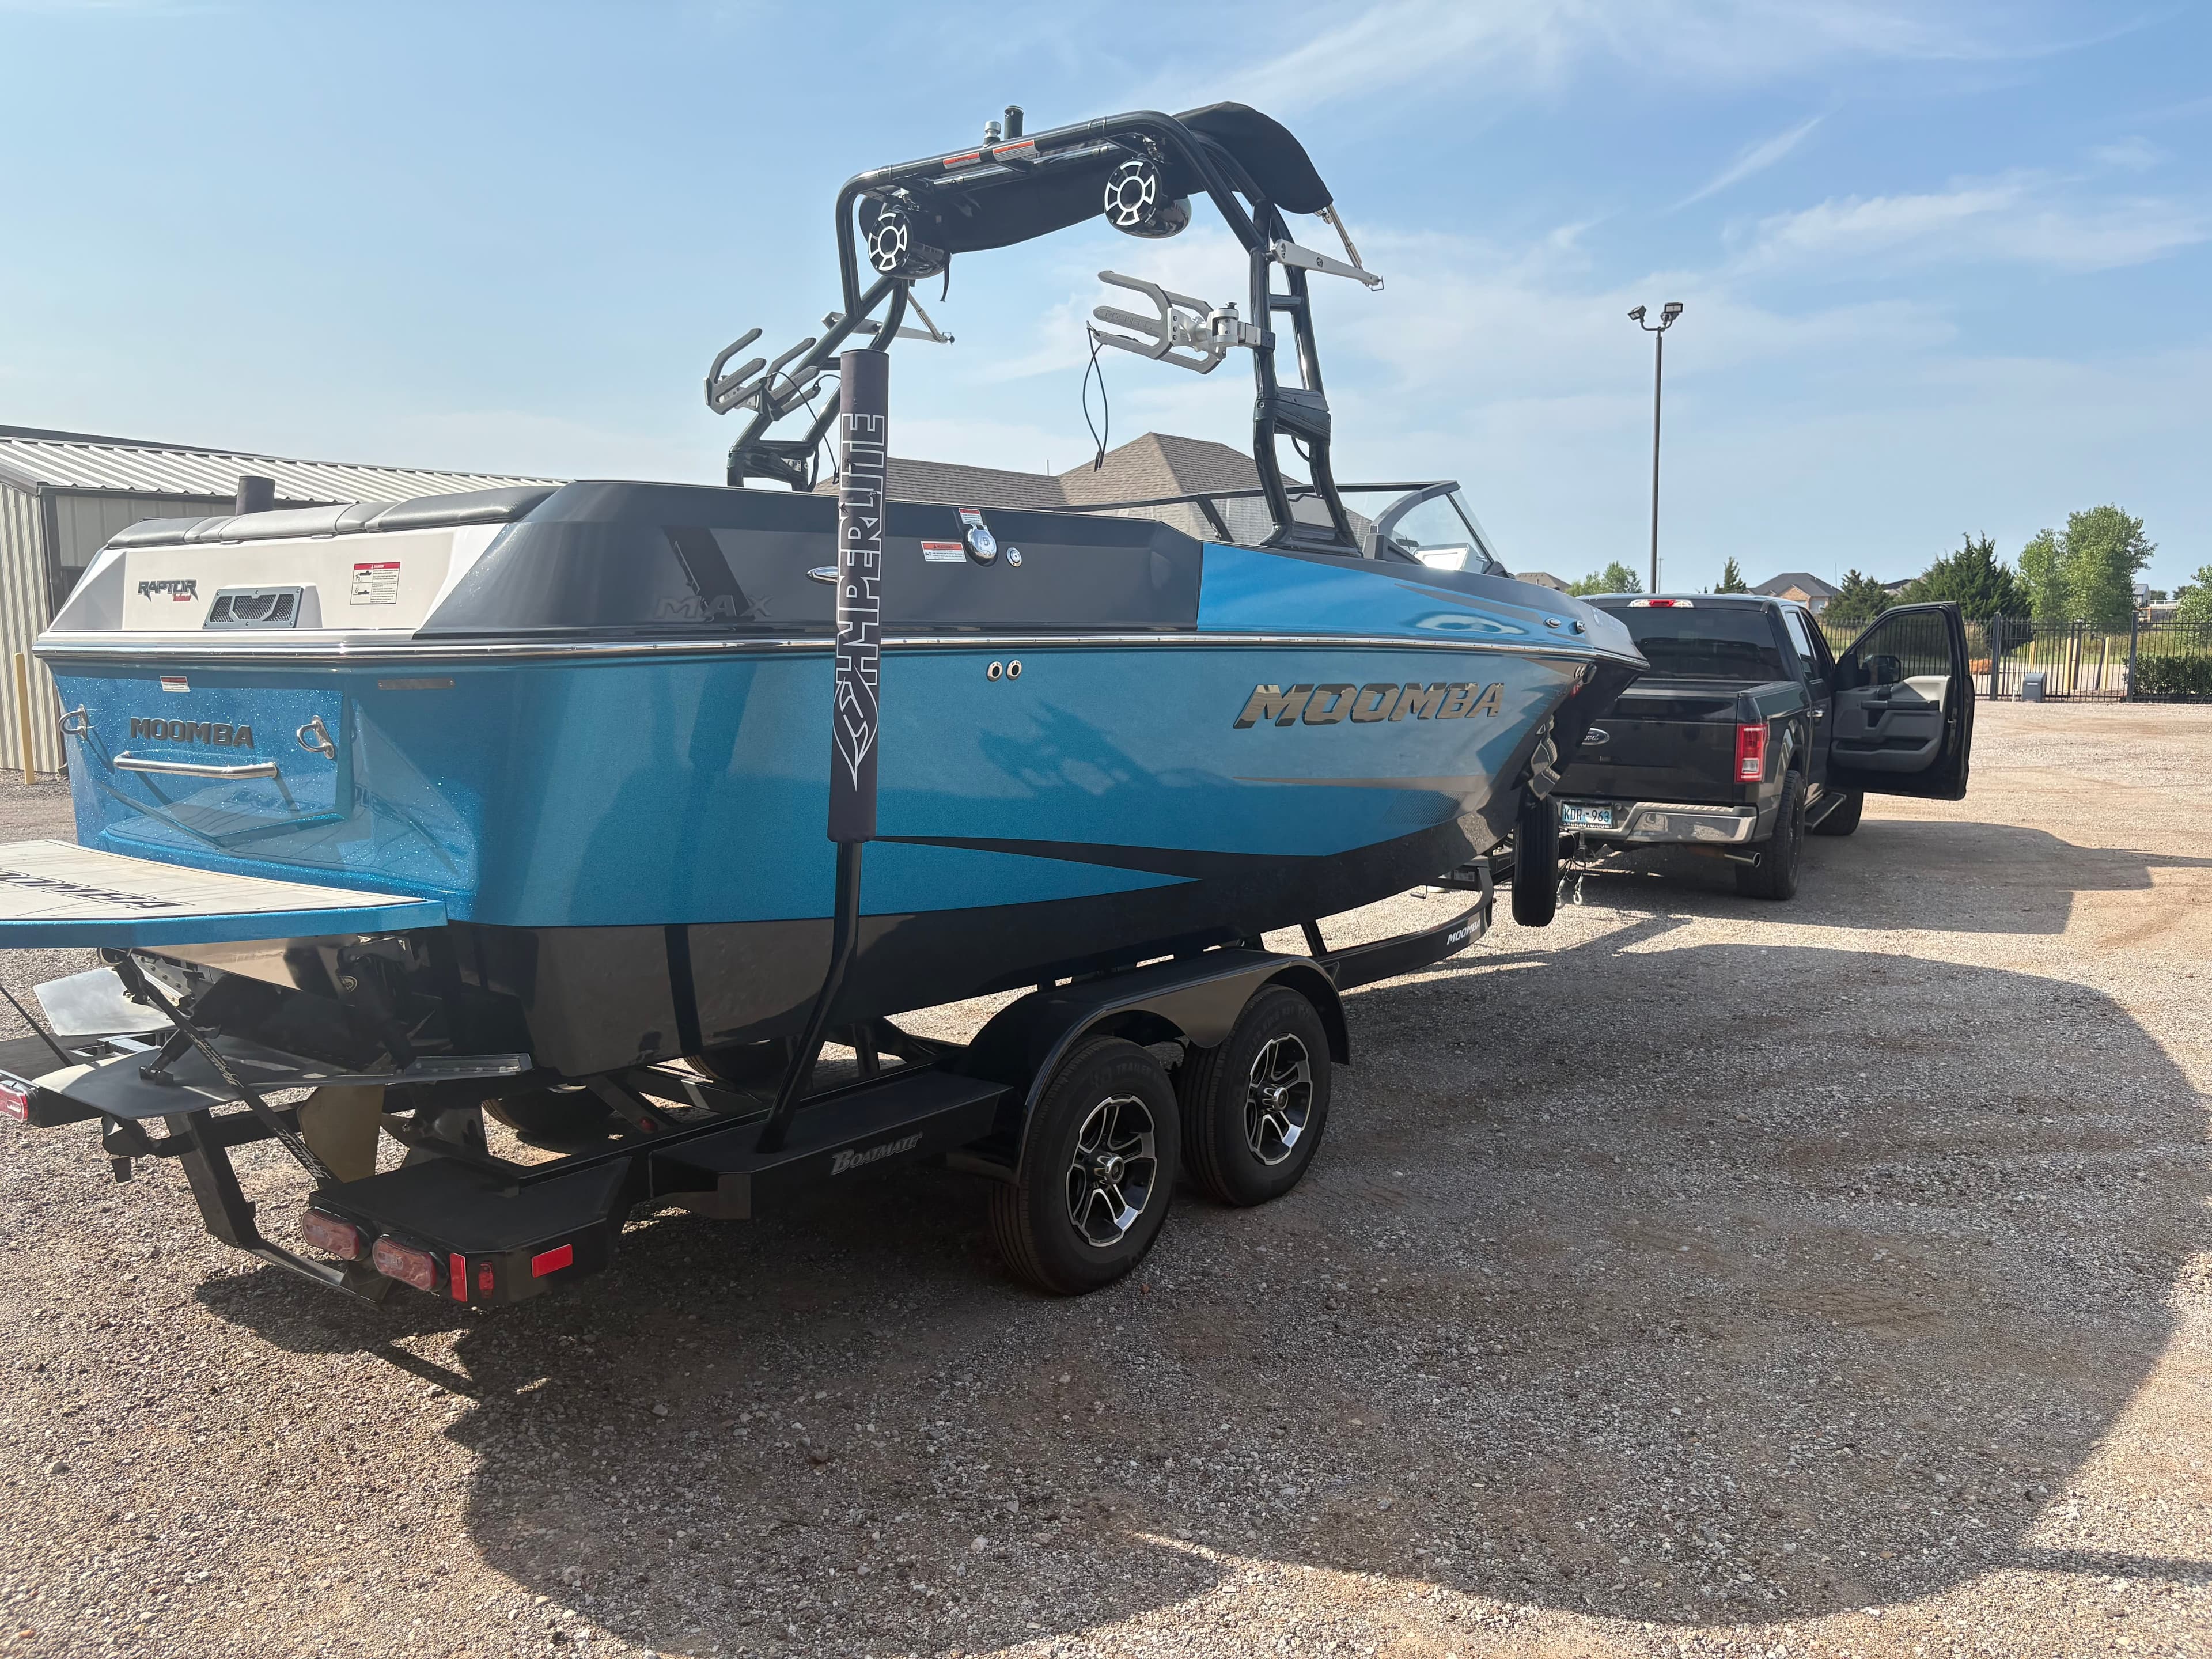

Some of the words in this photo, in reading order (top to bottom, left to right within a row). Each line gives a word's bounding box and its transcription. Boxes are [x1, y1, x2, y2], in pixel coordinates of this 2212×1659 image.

[836, 413, 885, 686] HYPERLITE
[138, 579, 199, 603] RAPTOR
[654, 594, 774, 619] MAX
[1233, 682, 1505, 729] MOOMBA
[130, 717, 254, 749] MOOMBA
[1446, 919, 1480, 945] MOOMBA
[830, 1133, 919, 1176] BOATMATE
